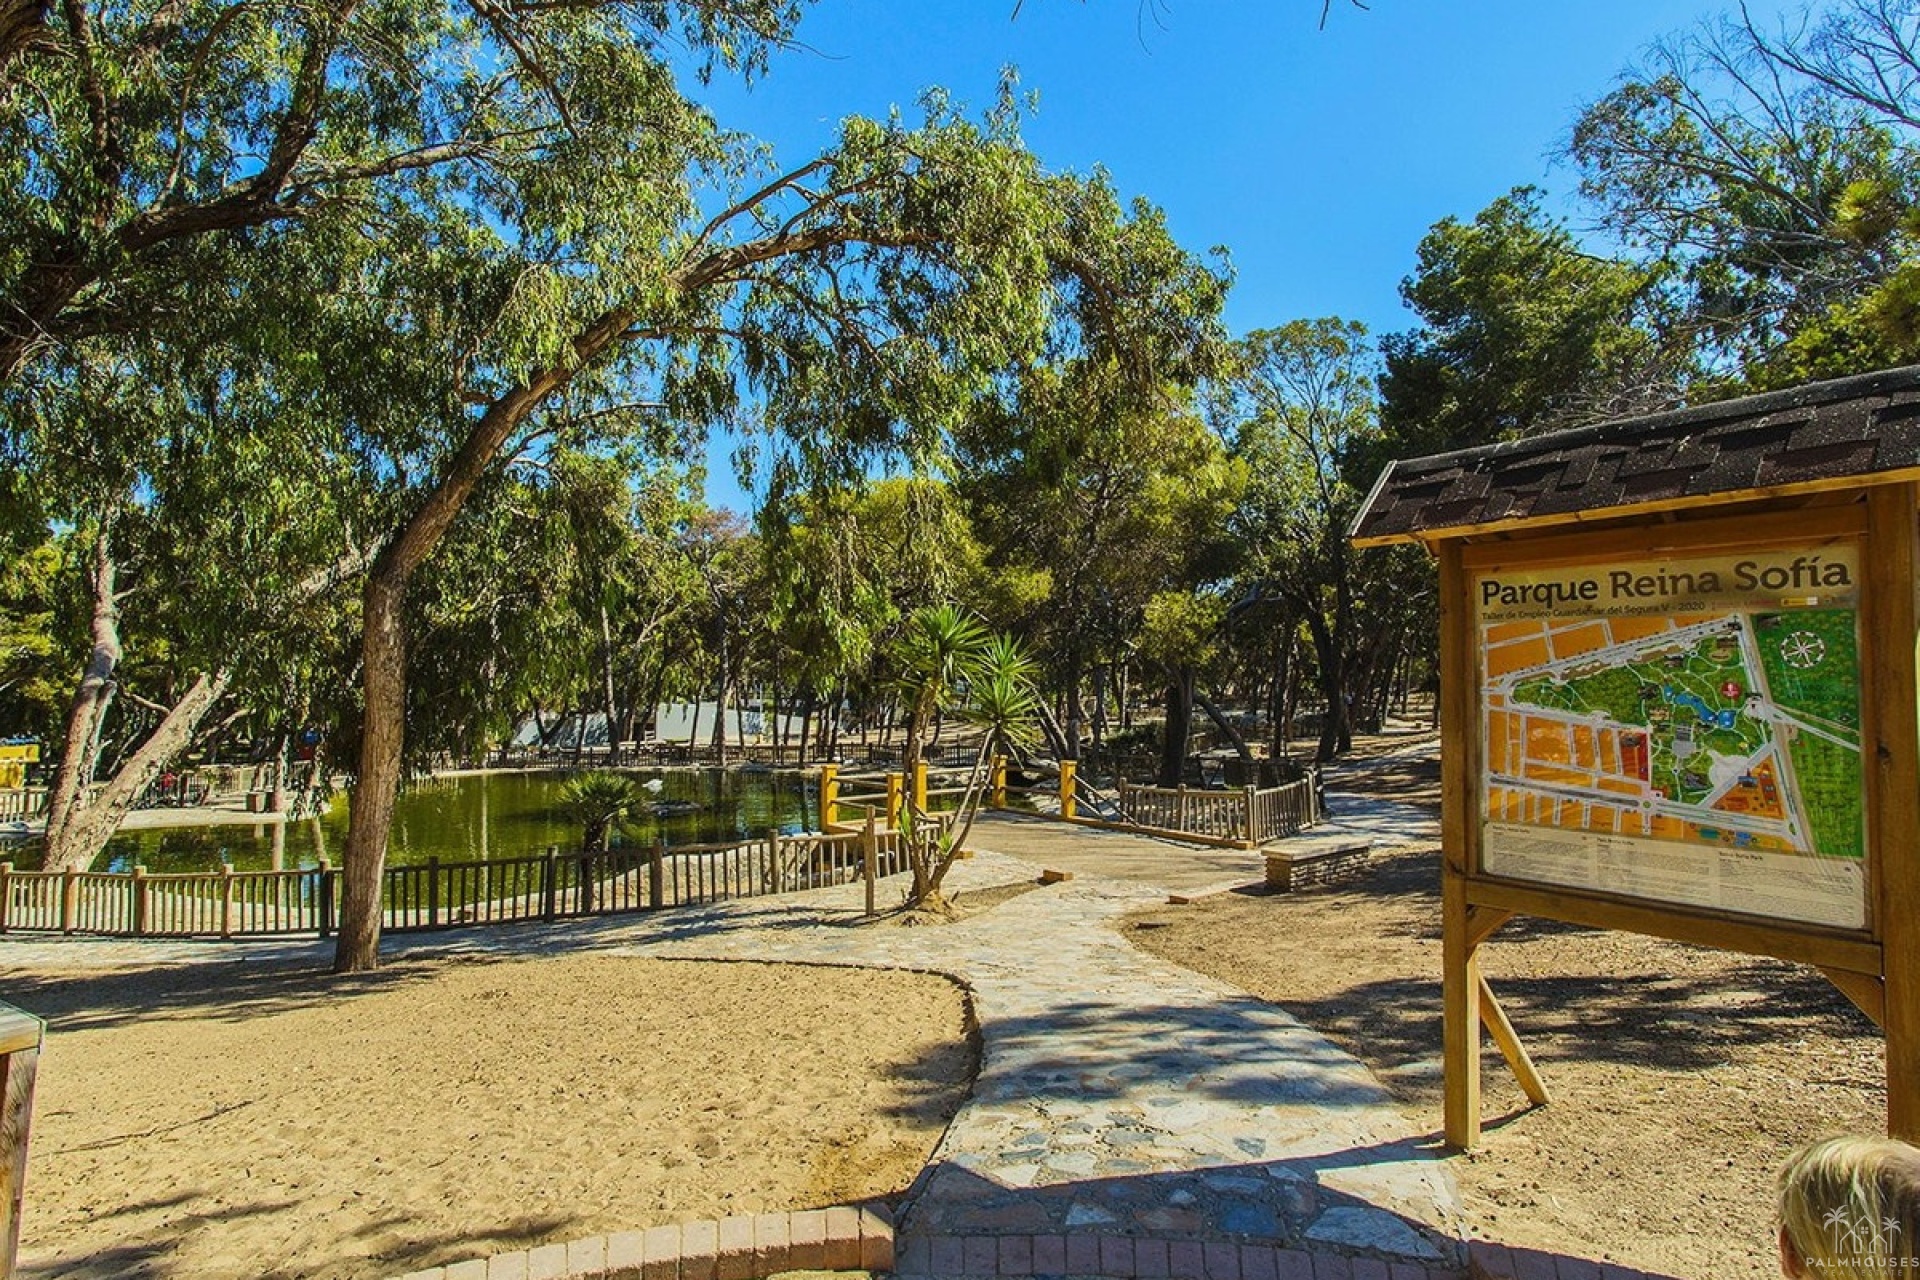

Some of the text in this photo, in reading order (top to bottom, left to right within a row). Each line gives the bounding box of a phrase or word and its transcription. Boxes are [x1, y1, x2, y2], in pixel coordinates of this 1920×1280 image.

[1481, 556, 1852, 609] Parque Reina Sofía
[1505, 611, 1516, 619] de
[1519, 609, 1551, 620] Empleo
[1607, 605, 1622, 615] del
[1624, 604, 1660, 615] Segura
[1678, 601, 1705, 612] 2020
